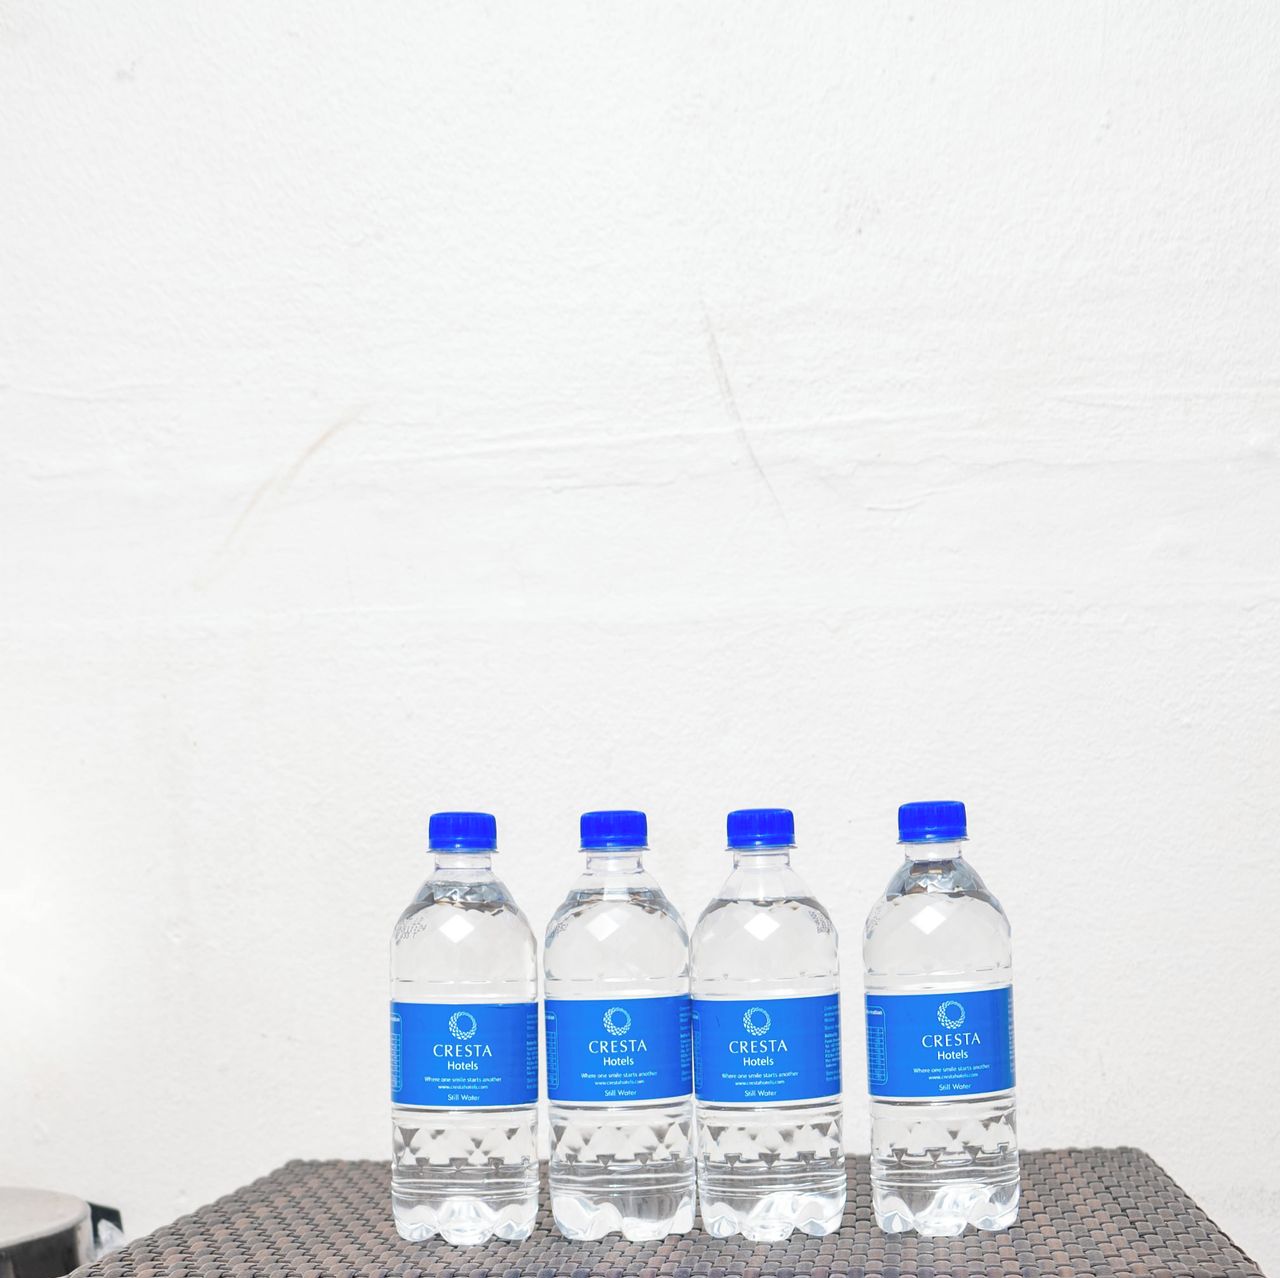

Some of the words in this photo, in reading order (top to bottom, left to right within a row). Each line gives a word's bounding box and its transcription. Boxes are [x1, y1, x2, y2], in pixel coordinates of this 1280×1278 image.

[922, 1032, 980, 1048] CRESTA
[433, 1044, 492, 1057] CRESTA
[589, 1040, 647, 1054] CRESTA
[729, 1040, 788, 1054] CRESTA
[938, 1050, 968, 1060] Hotels
[448, 1061, 478, 1070] Hotels
[604, 1056, 634, 1066] Hotels
[744, 1056, 774, 1066] Hotels
